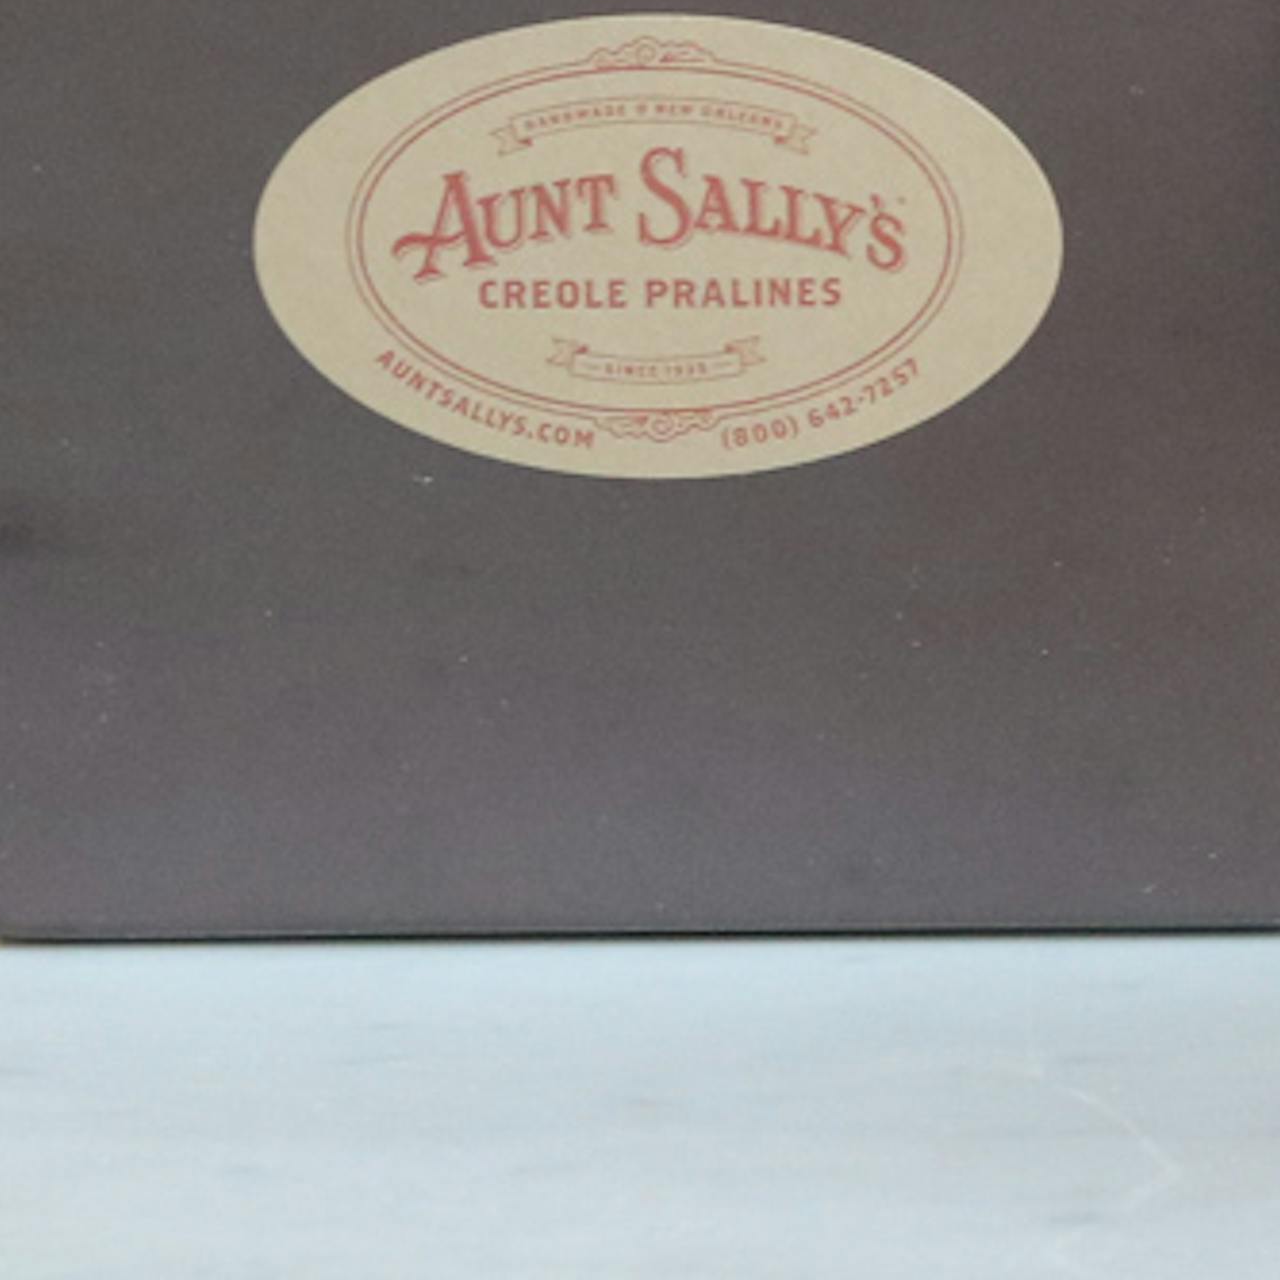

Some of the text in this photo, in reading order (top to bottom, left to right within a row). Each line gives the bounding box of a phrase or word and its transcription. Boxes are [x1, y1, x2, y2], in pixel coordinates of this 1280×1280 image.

[390, 170, 617, 282] AUNT
[478, 277, 843, 309] CREOLE PRALINES
[375, 348, 596, 450] AUNTSALLYS.COM
[722, 357, 921, 450] (800) 642-7257
